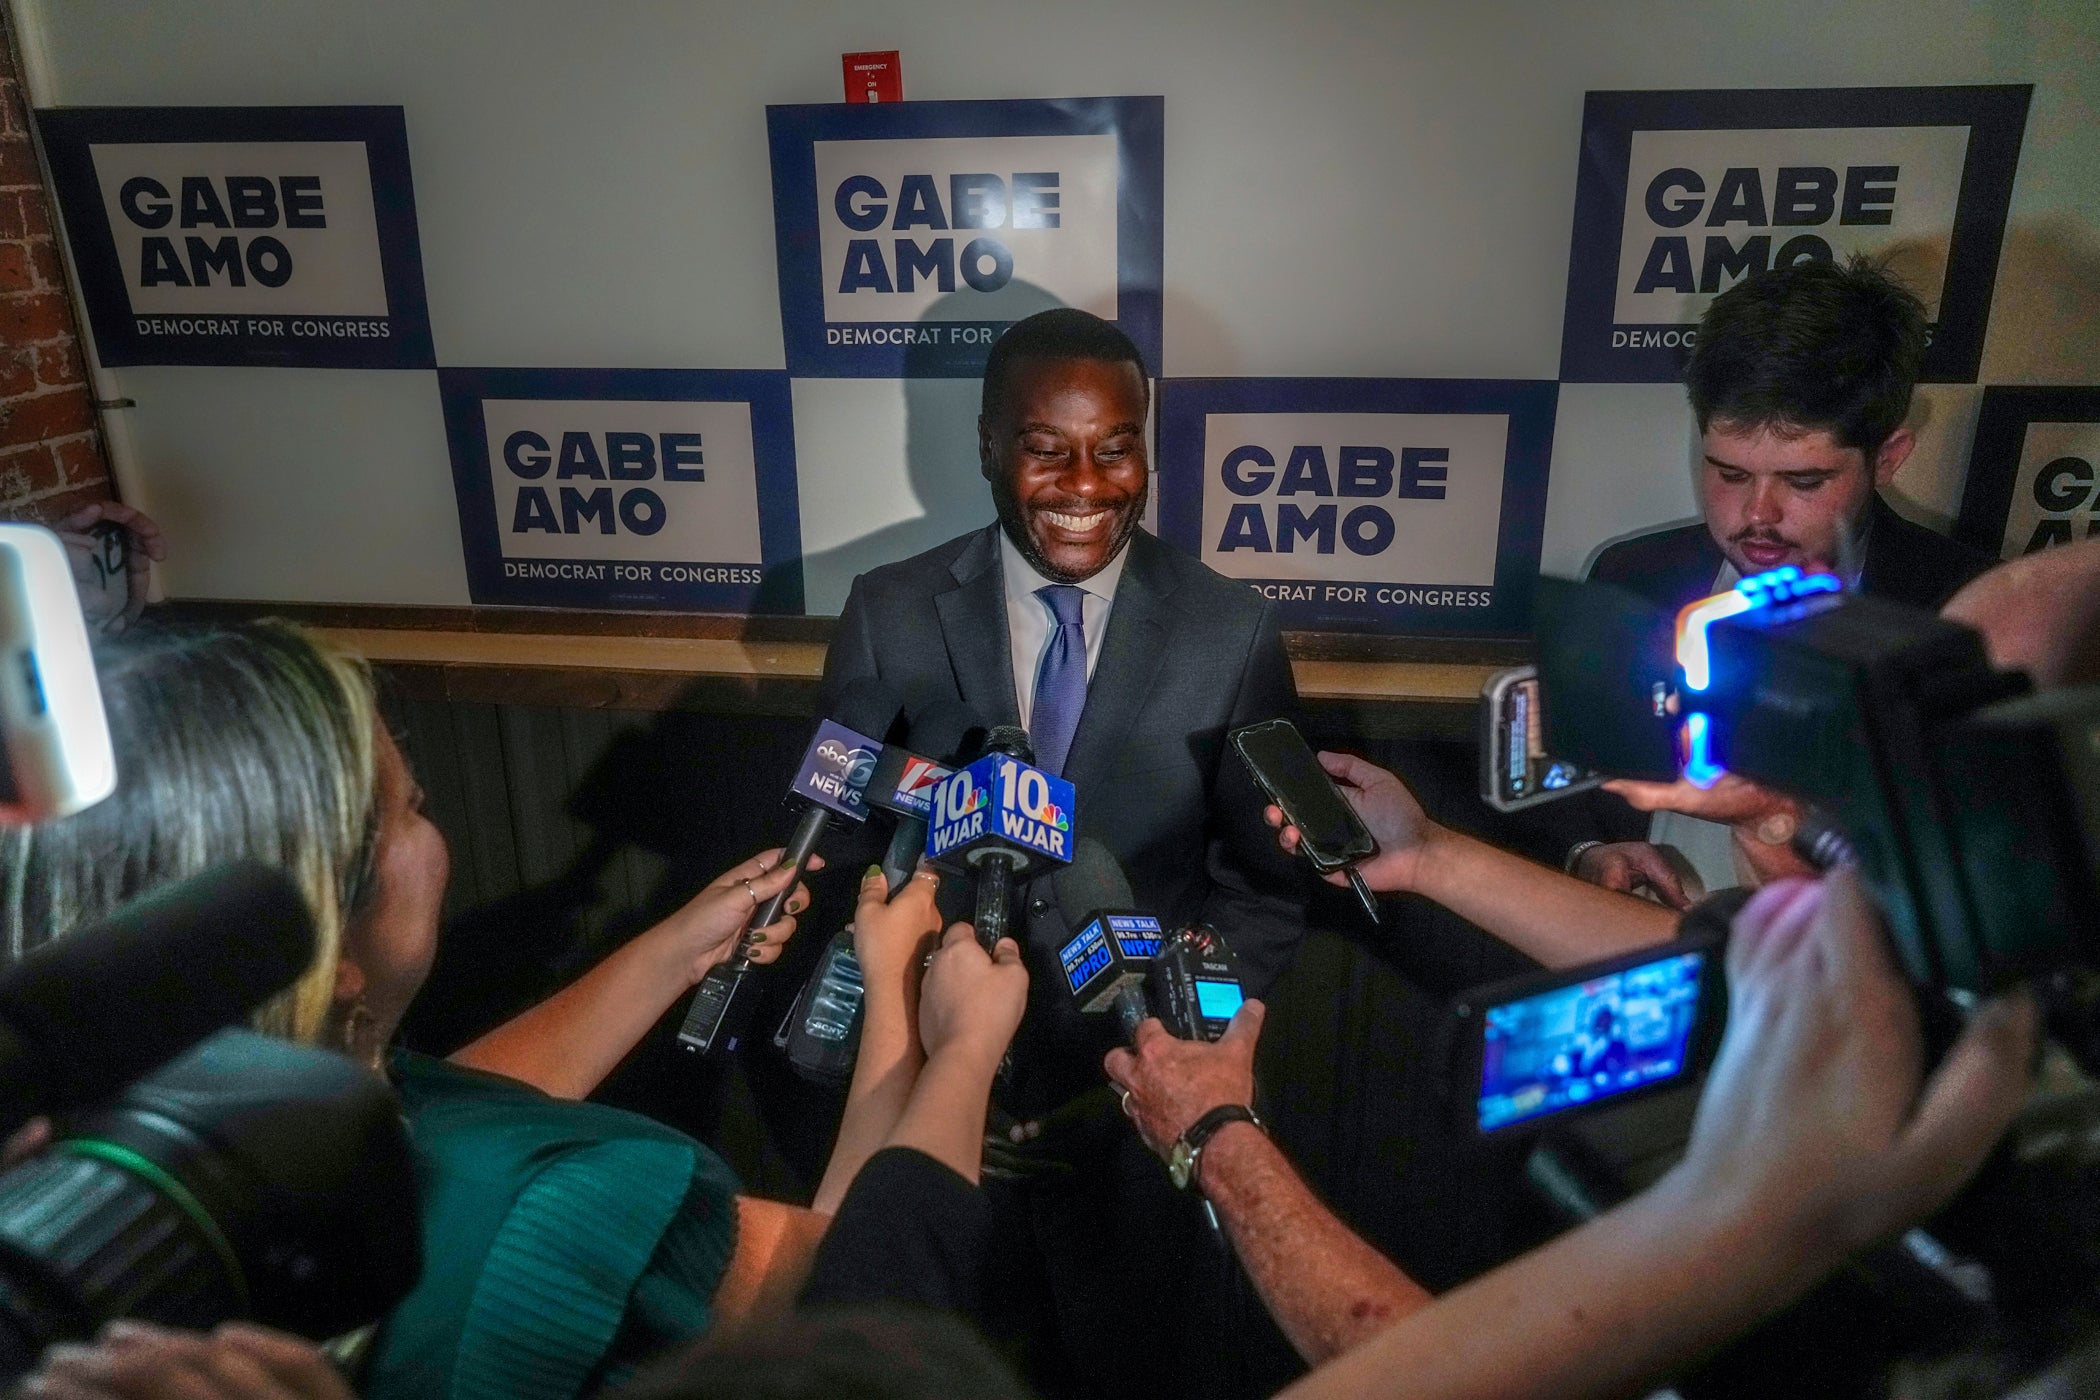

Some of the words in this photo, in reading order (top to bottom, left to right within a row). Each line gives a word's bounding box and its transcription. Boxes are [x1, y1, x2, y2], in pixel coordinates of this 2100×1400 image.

[120, 175, 327, 230] GABE
[834, 171, 1061, 232] GABE
[1644, 165, 1900, 229] GABE
[140, 235, 293, 288] AMO
[838, 236, 1014, 293] AMO
[137, 319, 239, 336] DEMOCRAT
[248, 320, 285, 337] FOR
[292, 321, 391, 338] CONGRESS
[826, 328, 942, 345] DEMOCRAT
[950, 327, 992, 344] FOR
[1612, 330, 1697, 348] DEMOC
[503, 430, 705, 482] GABE
[1221, 444, 1450, 500] GABE
[2033, 456, 2100, 513] G
[512, 486, 667, 536] AMO
[1216, 503, 1395, 557] AMO
[504, 563, 606, 580] DEMOCRAT
[615, 565, 652, 582] FOR
[660, 567, 762, 584] CONGRESS
[1249, 584, 1317, 601] CRAT
[1325, 586, 1366, 603] FOR
[1376, 588, 1491, 607] CONGRESS
[817, 746, 848, 765] abc
[809, 771, 863, 806] NEWS
[896, 791, 931, 811] NEWS
[933, 770, 973, 828] 10
[1000, 759, 1049, 820] 10
[933, 813, 984, 854] WJAR
[1001, 809, 1065, 857] WJAR
[1062, 941, 1082, 962] NEWS
[1080, 925, 1100, 945] TALK
[1111, 919, 1135, 928] NEWS
[1135, 919, 1157, 929] TALK
[1069, 945, 1110, 989] WPRO
